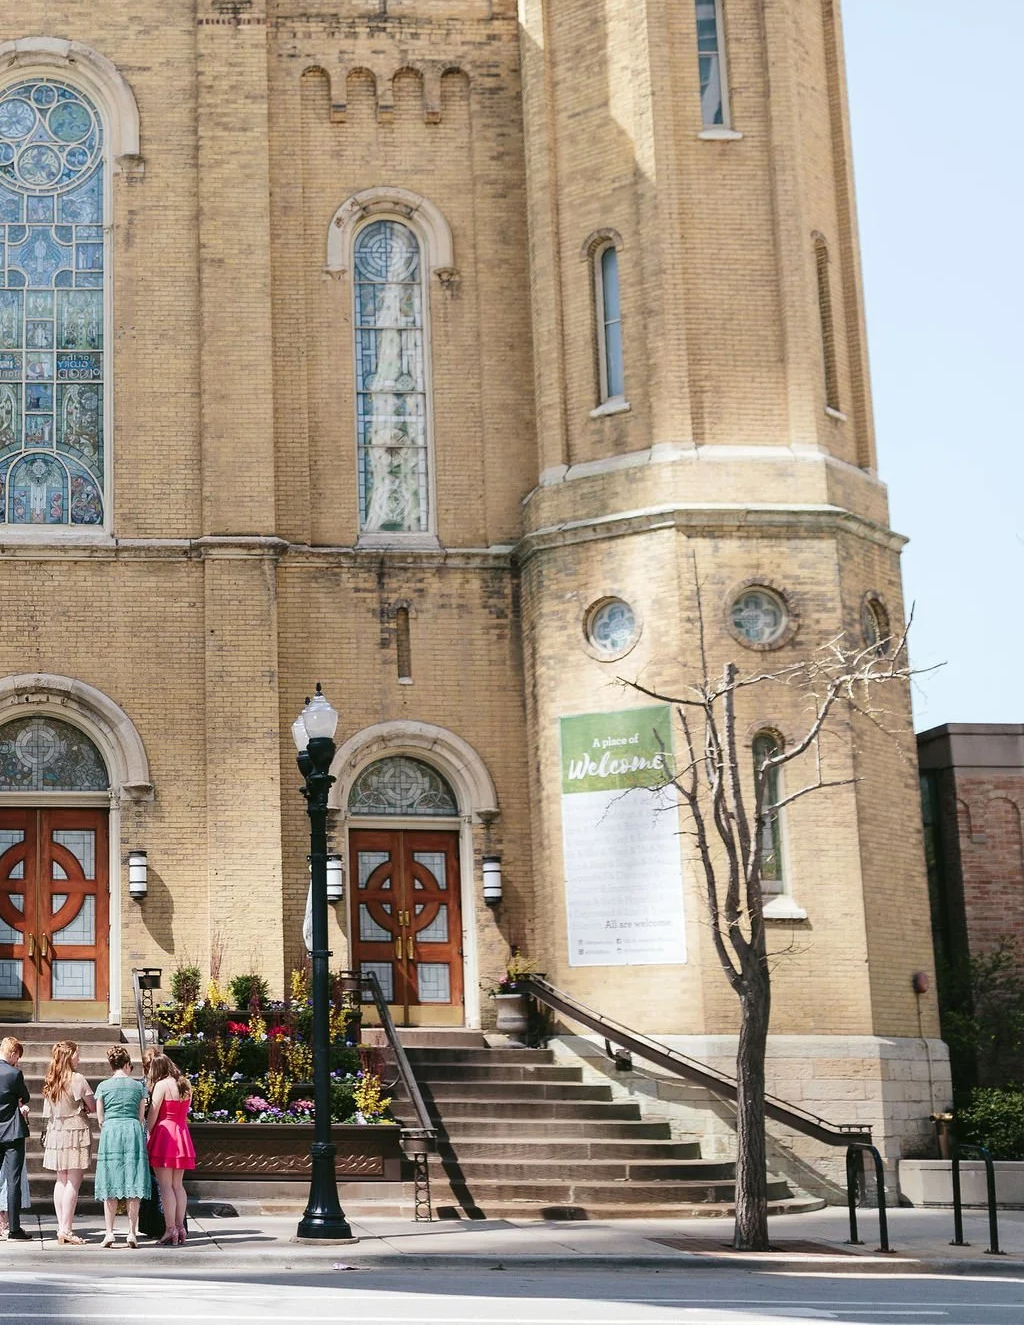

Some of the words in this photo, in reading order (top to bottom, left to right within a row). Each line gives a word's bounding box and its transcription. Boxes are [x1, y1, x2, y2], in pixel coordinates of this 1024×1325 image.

[592, 738, 601, 748] A
[602, 736, 627, 749] place
[628, 733, 640, 744] of
[567, 751, 665, 780] Welcome
[604, 919, 618, 929] All
